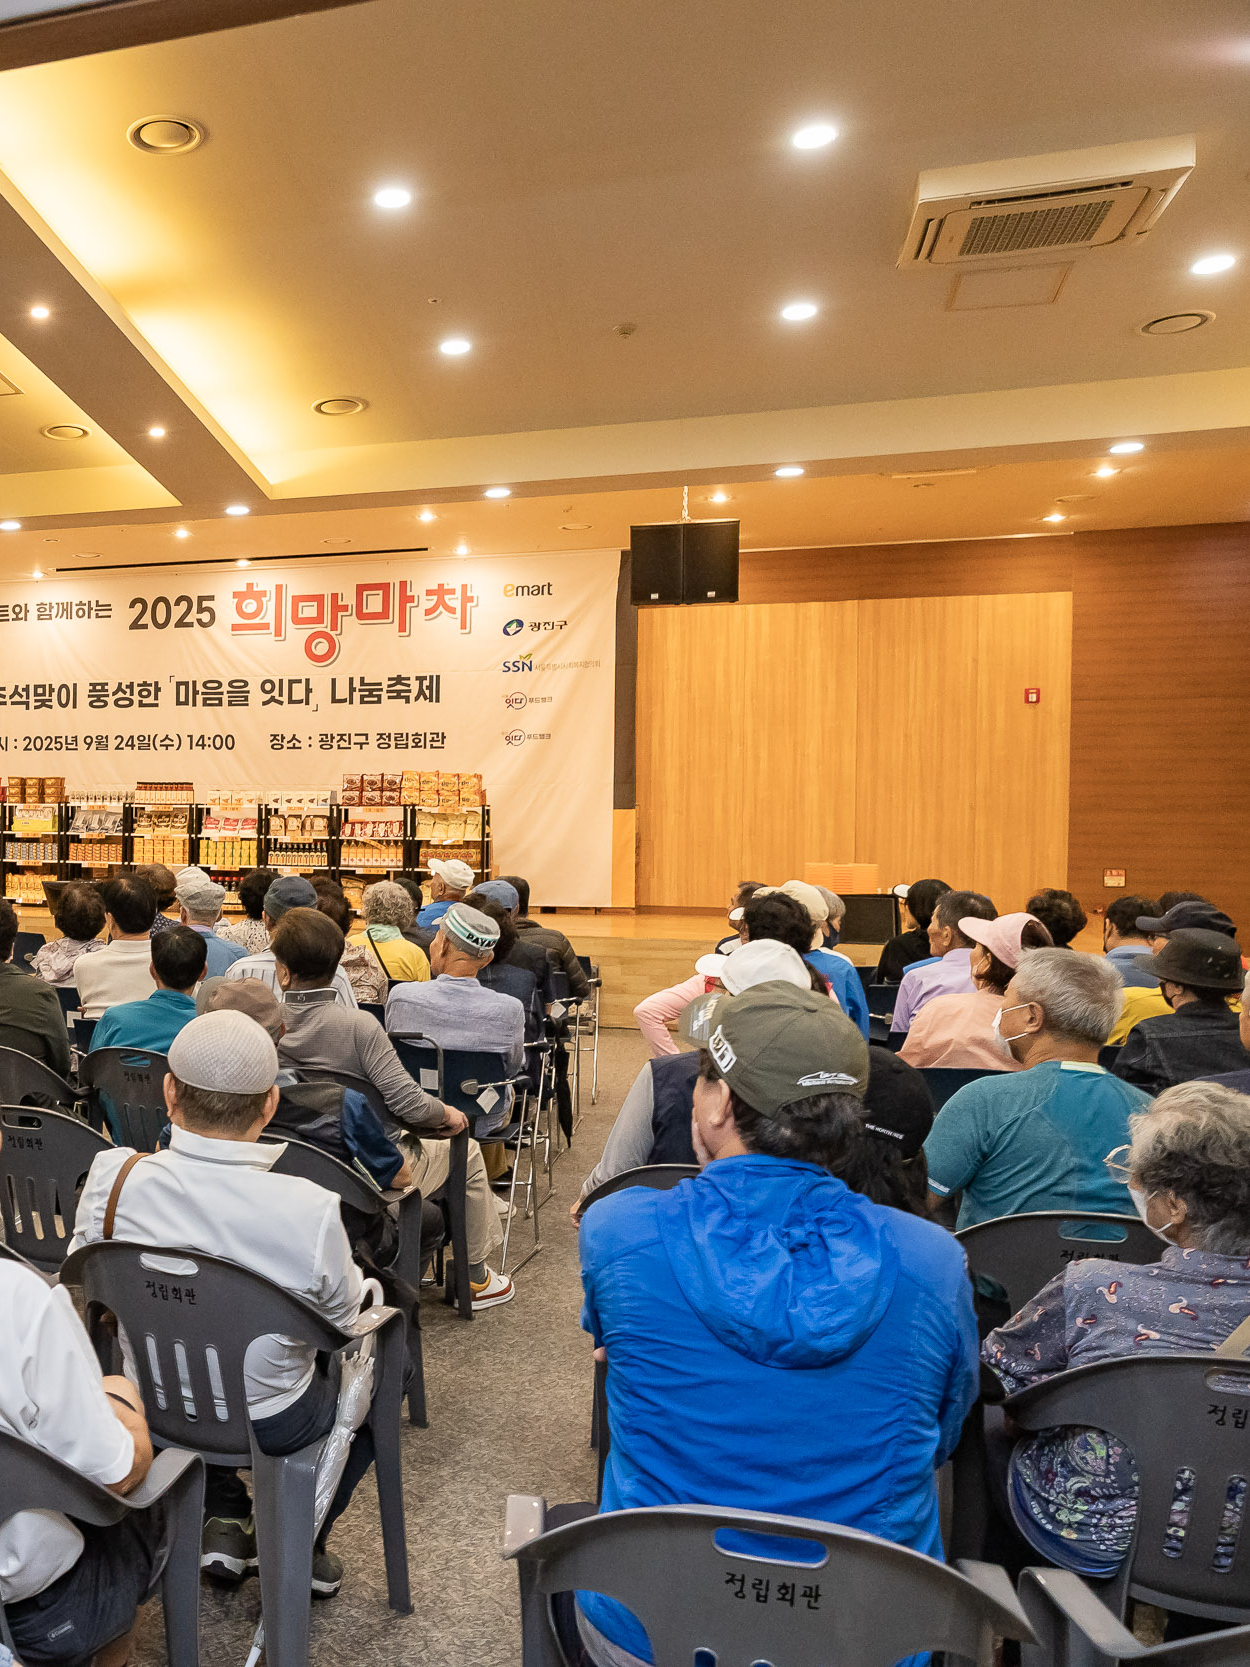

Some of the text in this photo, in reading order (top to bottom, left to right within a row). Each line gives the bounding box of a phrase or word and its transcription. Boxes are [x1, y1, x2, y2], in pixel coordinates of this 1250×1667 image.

[503, 582, 553, 598] emart
[36, 600, 112, 621] 함께하는
[128, 594, 217, 631] 2025
[230, 580, 479, 667] 희망마차
[527, 620, 568, 632] 광진구
[502, 660, 533, 673] SSN
[87, 680, 162, 709] 풍성한
[330, 674, 442, 705] 나눔축제
[22, 734, 79, 752] 2025년
[83, 734, 109, 751] 9월
[114, 733, 182, 751] 24일(수)
[187, 733, 236, 751] 14:00
[269, 733, 302, 750] 장소
[318, 732, 370, 750] 광진구
[376, 731, 447, 750] 정립회관
[8, 1135, 44, 1151] 정립회관
[145, 1280, 197, 1305] 정립회관
[724, 1571, 822, 1610] 정립회관
